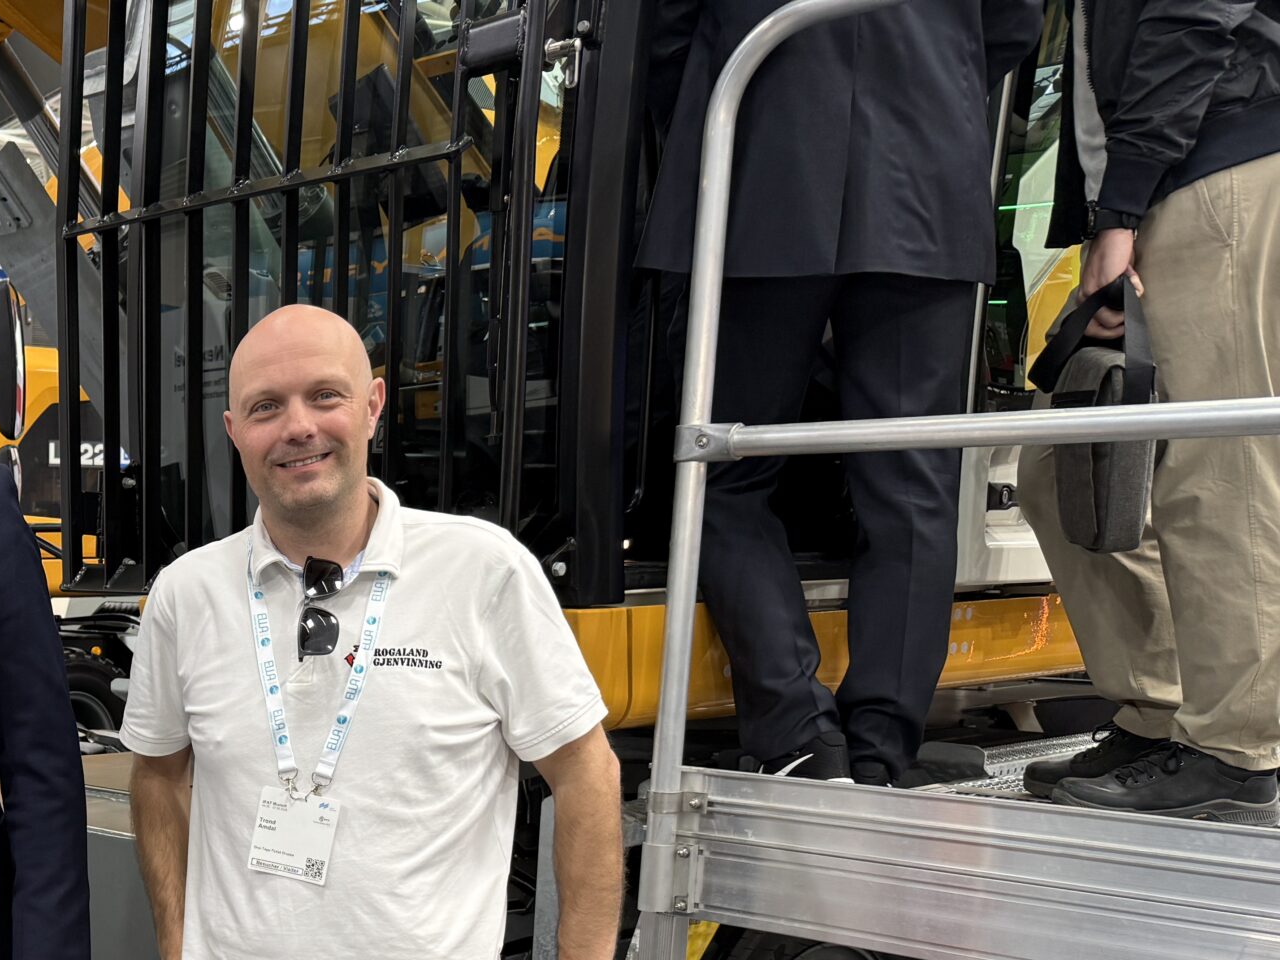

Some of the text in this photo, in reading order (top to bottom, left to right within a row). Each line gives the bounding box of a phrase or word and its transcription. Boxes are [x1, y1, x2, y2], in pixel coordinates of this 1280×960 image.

[371, 580, 386, 602] ELLA
[256, 612, 270, 634] ELLA
[362, 629, 375, 651] ELLA
[373, 648, 429, 658] ROGALAND
[373, 658, 443, 670] GJENVINNING
[263, 659, 277, 682] ELLA
[344, 678, 361, 701] ELLA
[272, 708, 286, 732] ELLA
[326, 728, 344, 752] ELLA
